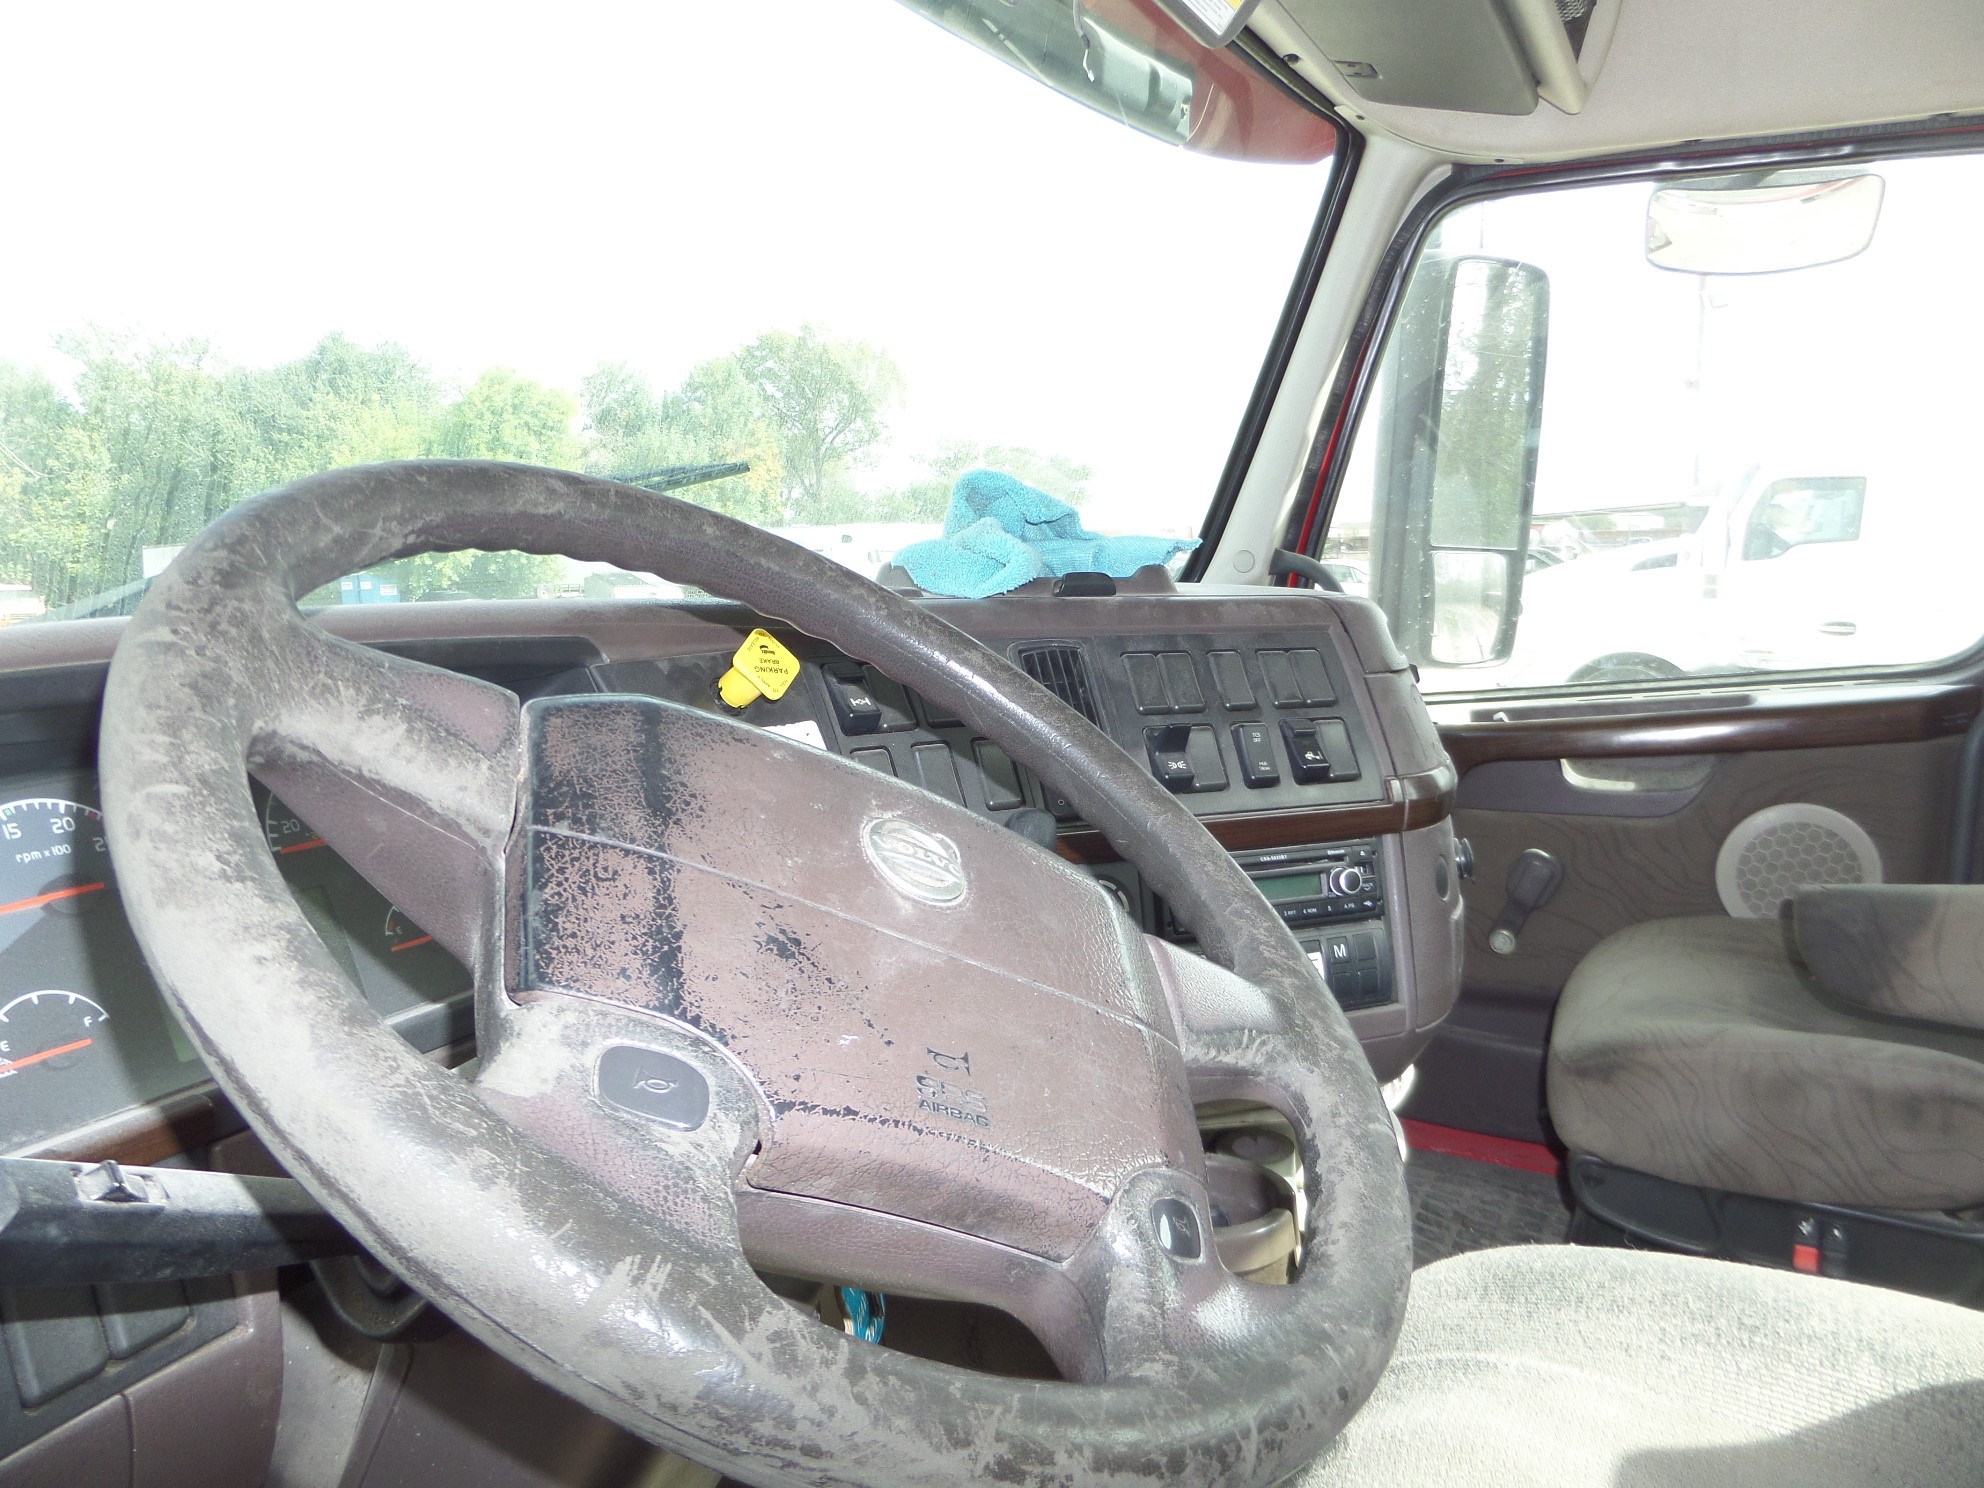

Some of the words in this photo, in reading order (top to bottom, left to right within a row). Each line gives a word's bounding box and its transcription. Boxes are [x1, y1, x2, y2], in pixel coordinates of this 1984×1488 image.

[759, 657, 780, 665] BRAKE
[754, 665, 789, 675] PARKING
[2, 822, 22, 840] 15
[50, 816, 76, 834] 20
[281, 818, 300, 834] 20
[92, 836, 108, 852] 2
[15, 851, 42, 863] rpm
[871, 835, 962, 877] VOLVO
[1333, 943, 1347, 959] M
[83, 1015, 93, 1028] F
[0, 1040, 11, 1052] E
[918, 1099, 990, 1127] AIRBAG
